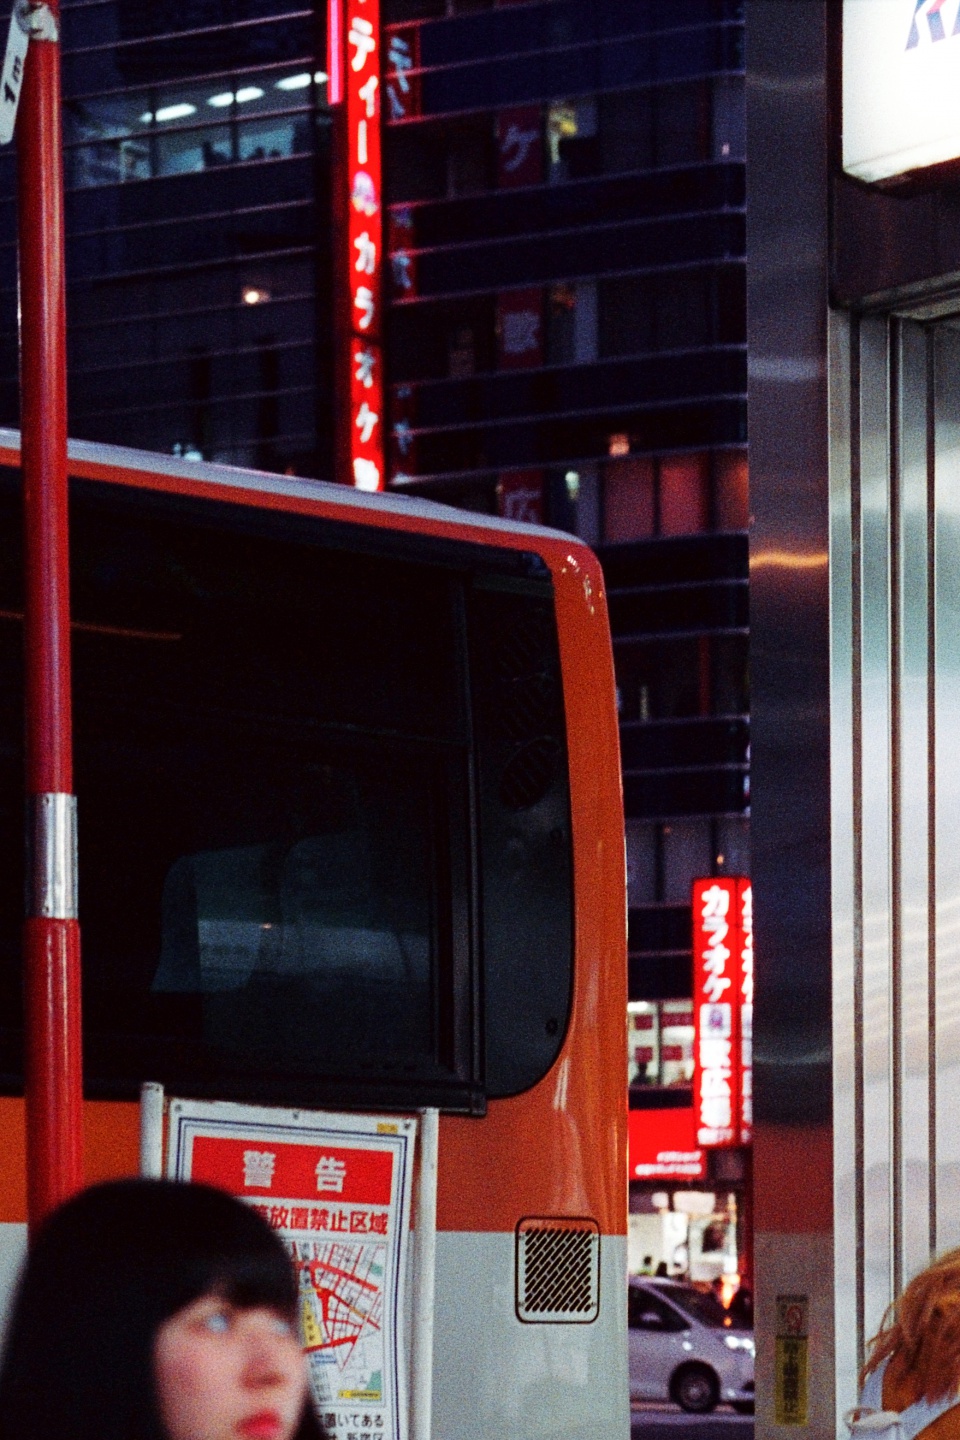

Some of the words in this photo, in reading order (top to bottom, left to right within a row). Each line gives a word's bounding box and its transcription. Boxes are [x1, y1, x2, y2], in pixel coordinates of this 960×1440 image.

[701, 885, 731, 1002] カラオケ
[243, 1149, 347, 1193] 警告
